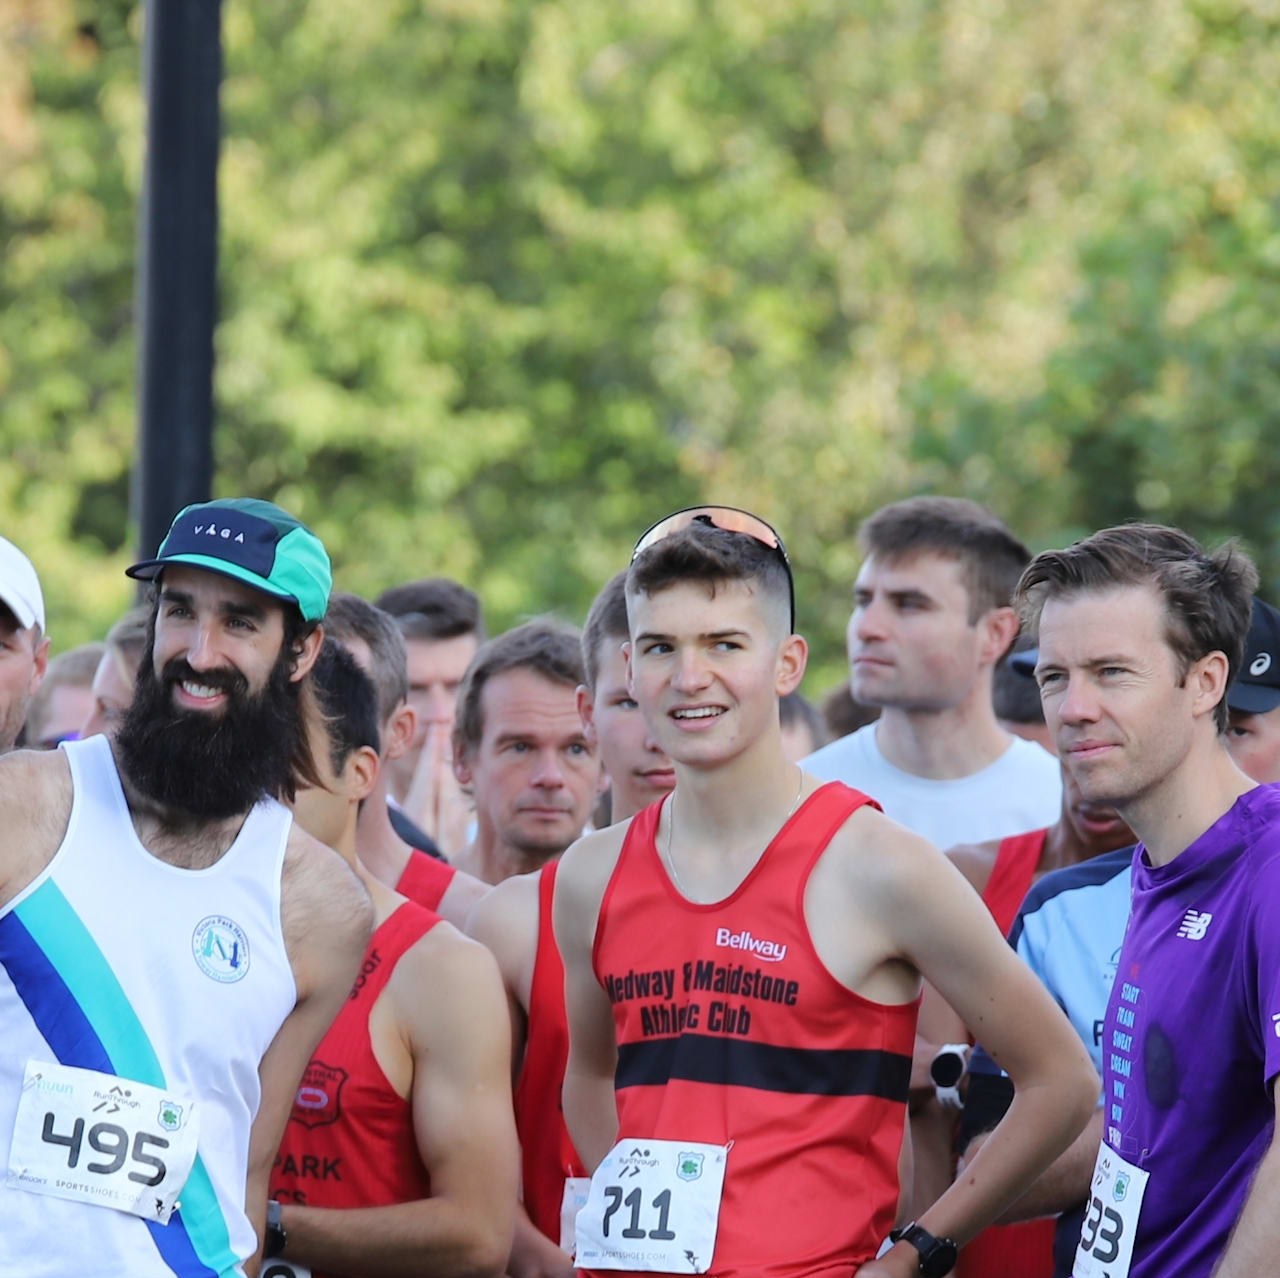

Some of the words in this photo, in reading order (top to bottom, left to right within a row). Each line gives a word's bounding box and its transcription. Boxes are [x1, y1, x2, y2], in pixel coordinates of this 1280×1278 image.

[715, 928, 787, 962] Bellway
[693, 960, 800, 1006] Maidstone
[706, 1001, 752, 1035] Club
[41, 1111, 170, 1187] 495
[603, 1185, 676, 1241] 711
